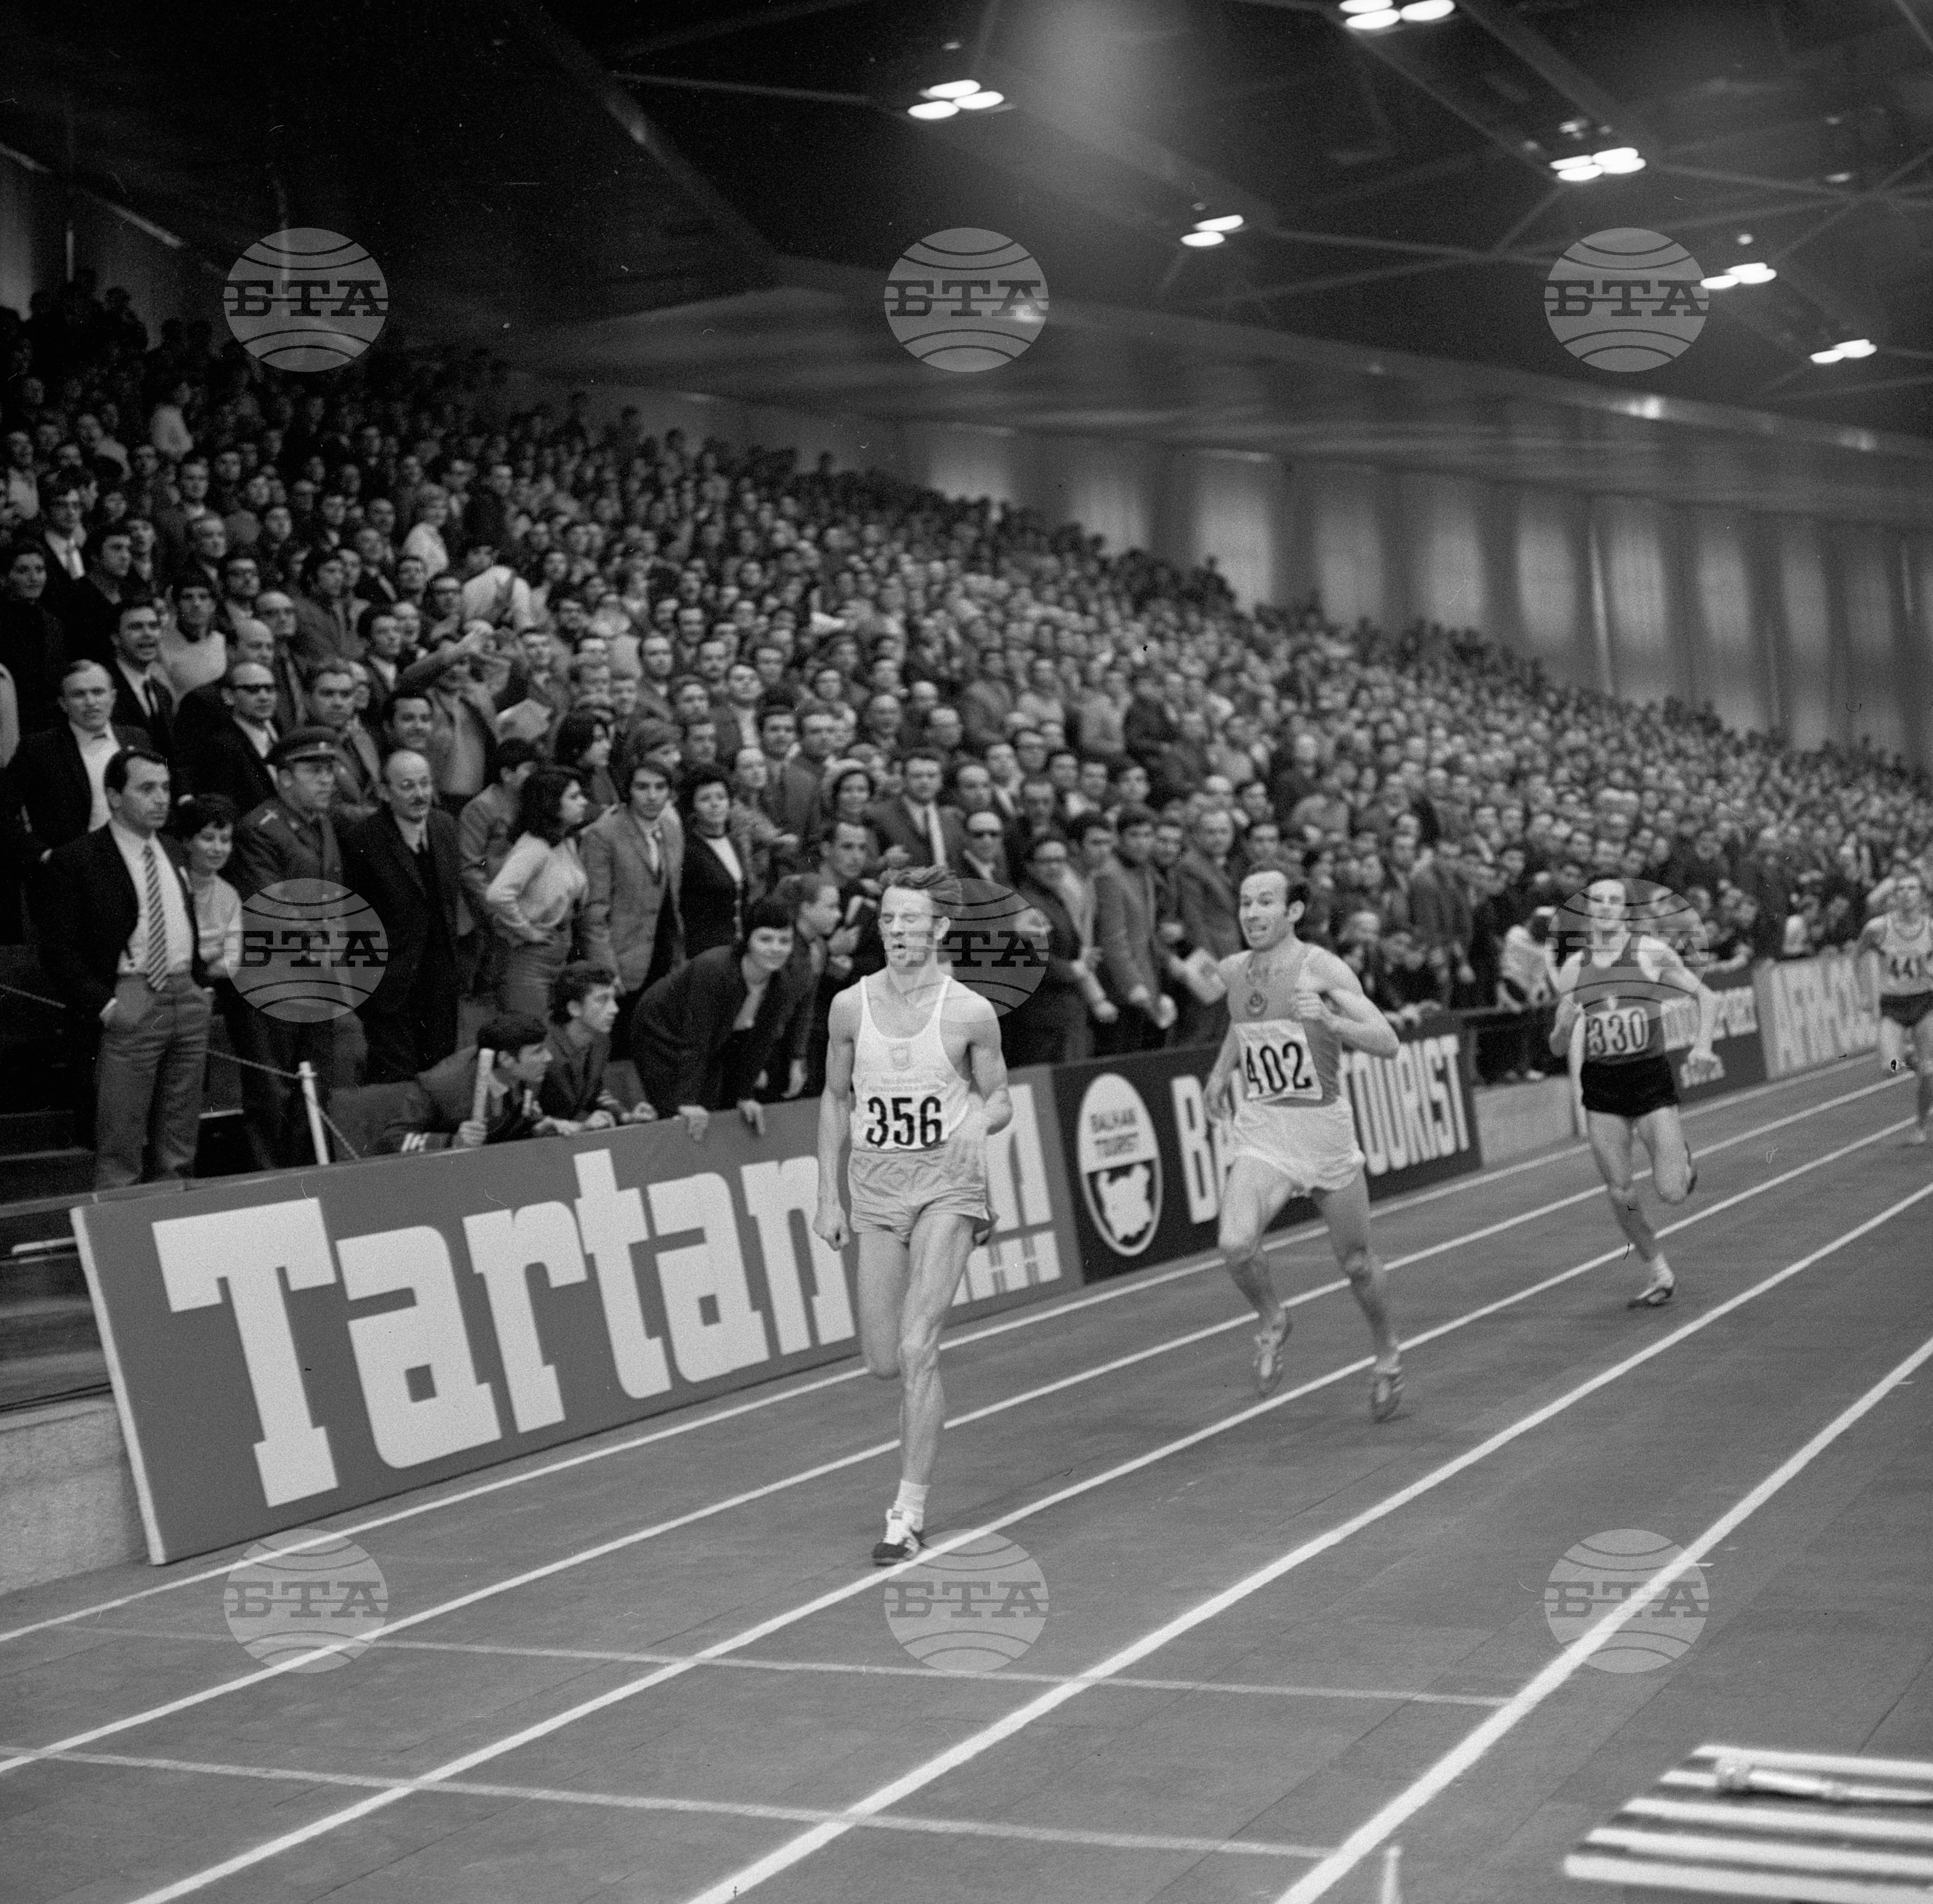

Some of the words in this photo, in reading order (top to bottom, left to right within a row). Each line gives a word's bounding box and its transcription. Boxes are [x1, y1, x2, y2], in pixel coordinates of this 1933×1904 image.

[1592, 1010, 1644, 1054] 330
[1246, 1041, 1313, 1094] 402
[866, 1096, 942, 1147] 356
[152, 1148, 855, 1507] Tartan
